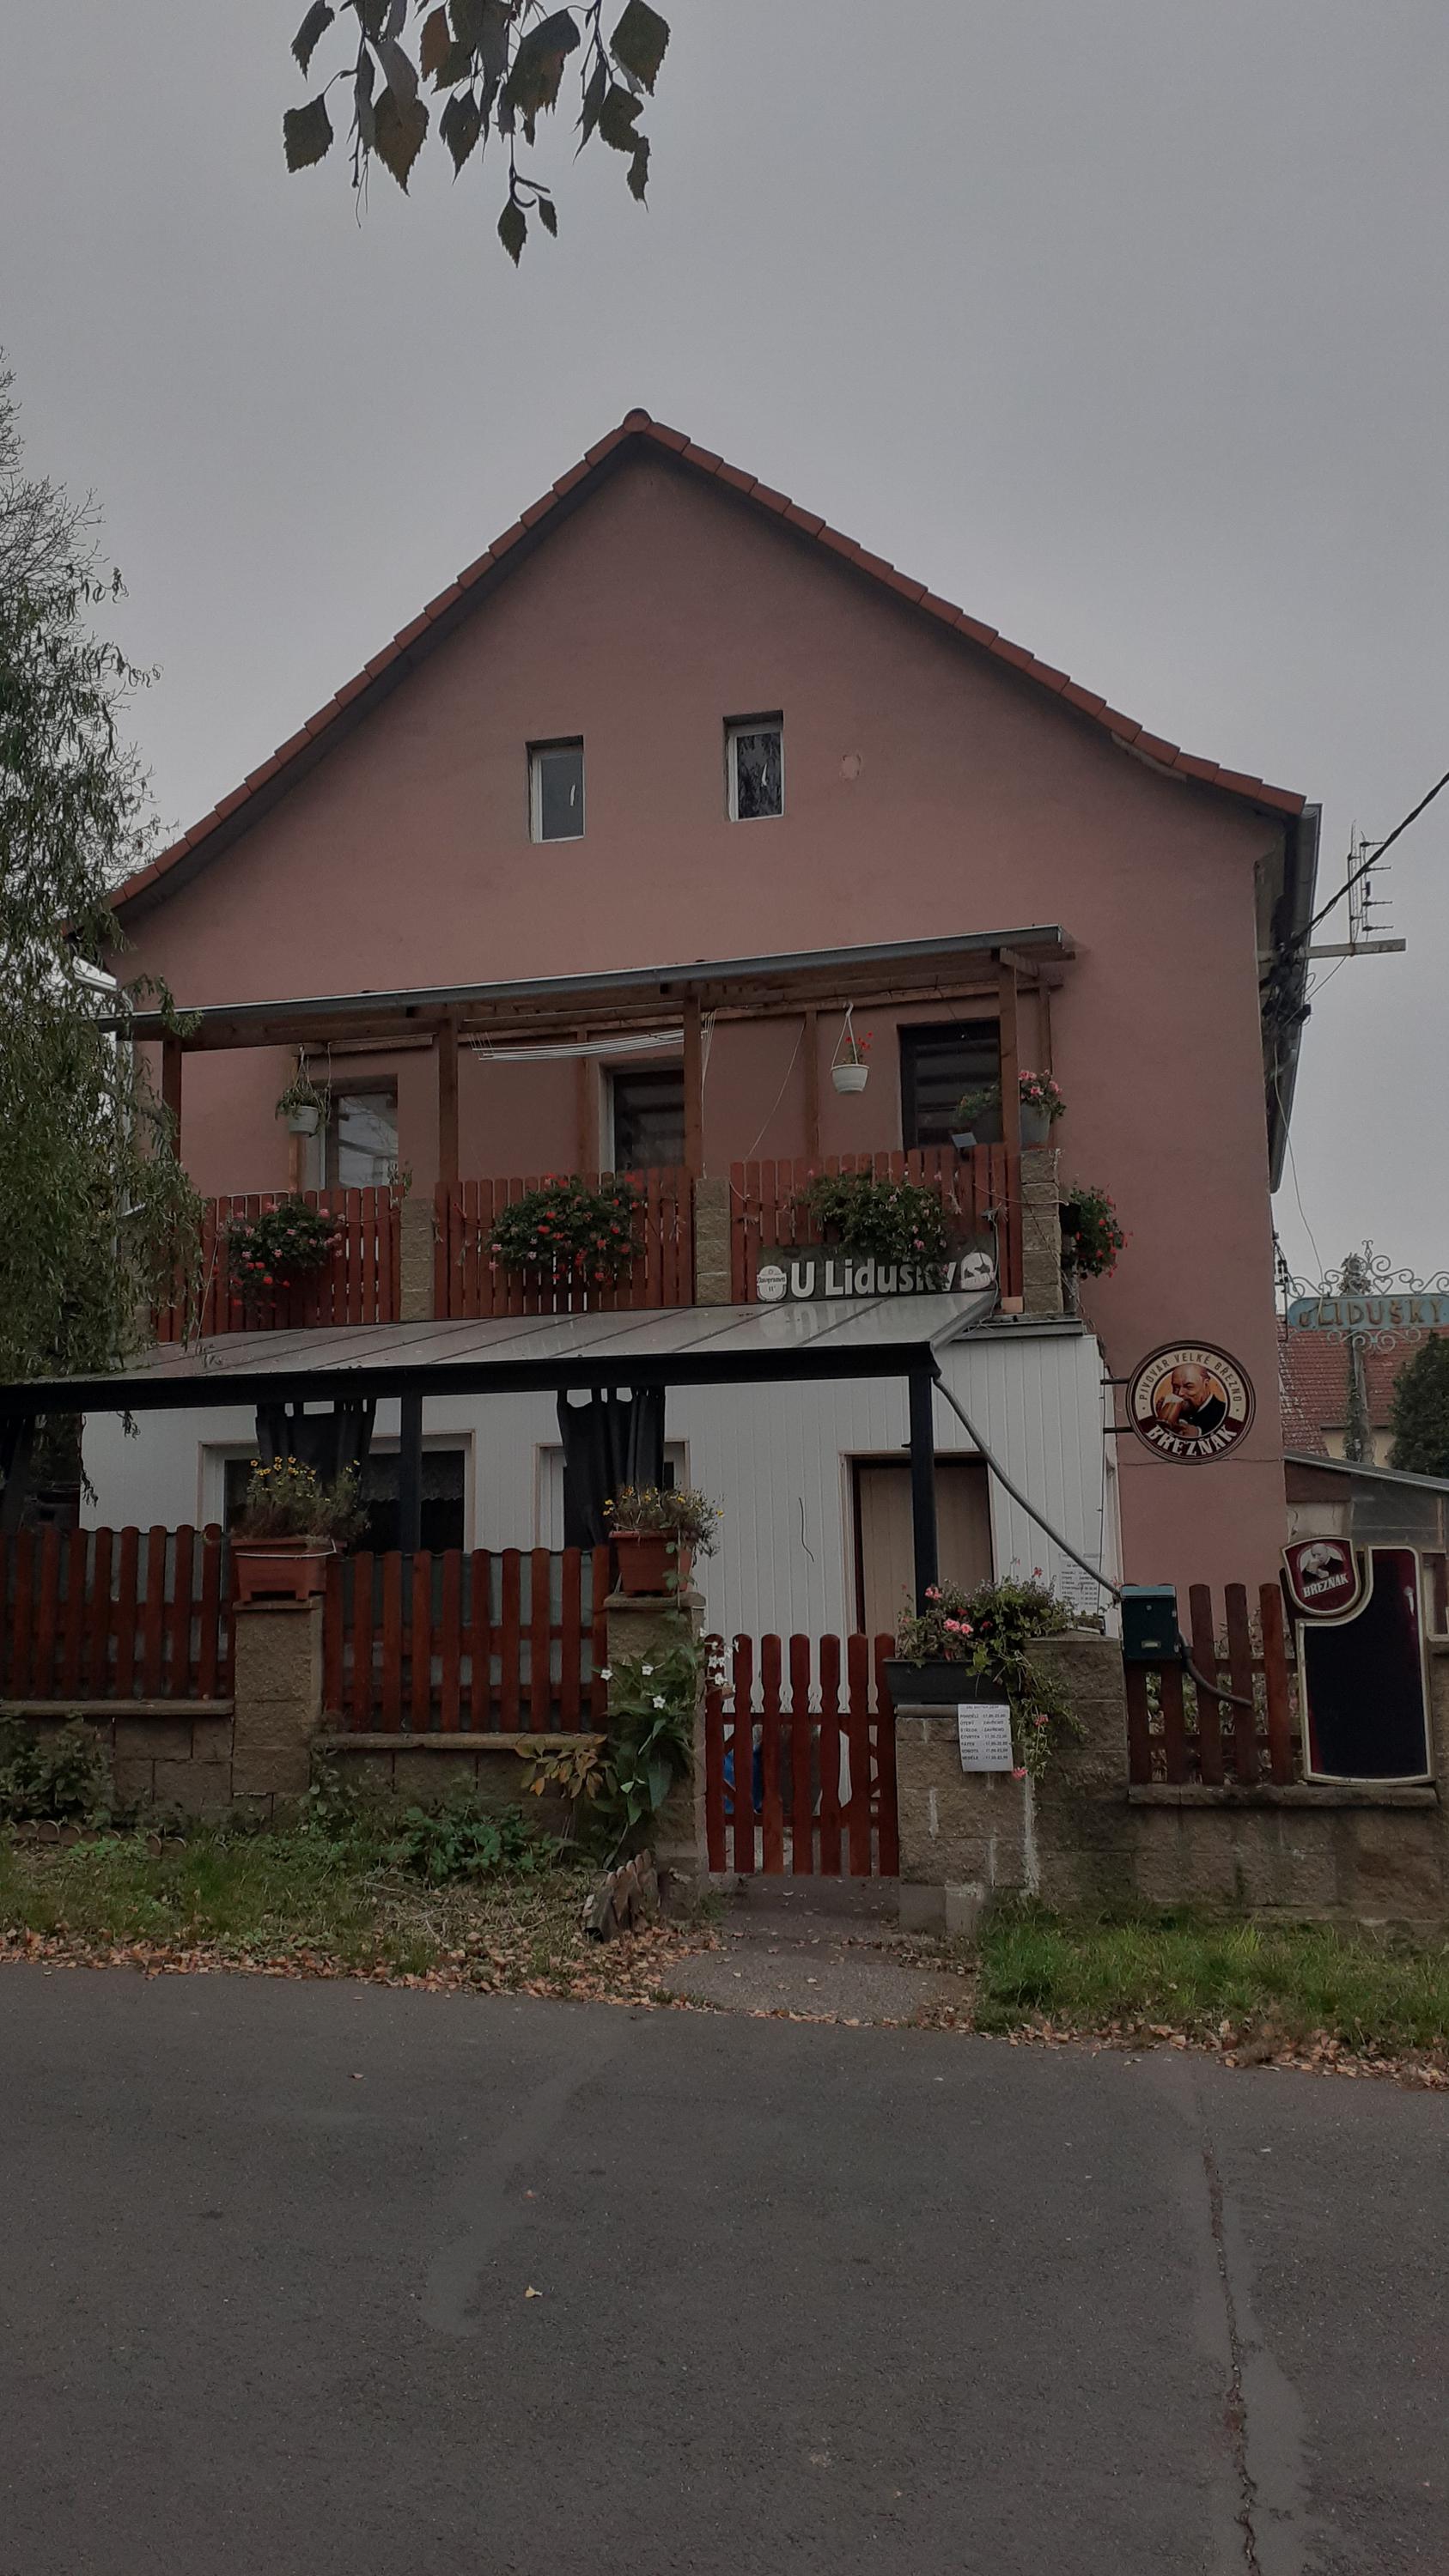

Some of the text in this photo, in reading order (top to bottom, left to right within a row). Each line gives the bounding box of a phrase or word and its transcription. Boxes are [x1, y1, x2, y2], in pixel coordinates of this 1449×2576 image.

[791, 1261, 815, 1298] U
[1139, 1352, 1243, 1402] PIVOVAR VELKÉ BŘEZNO
